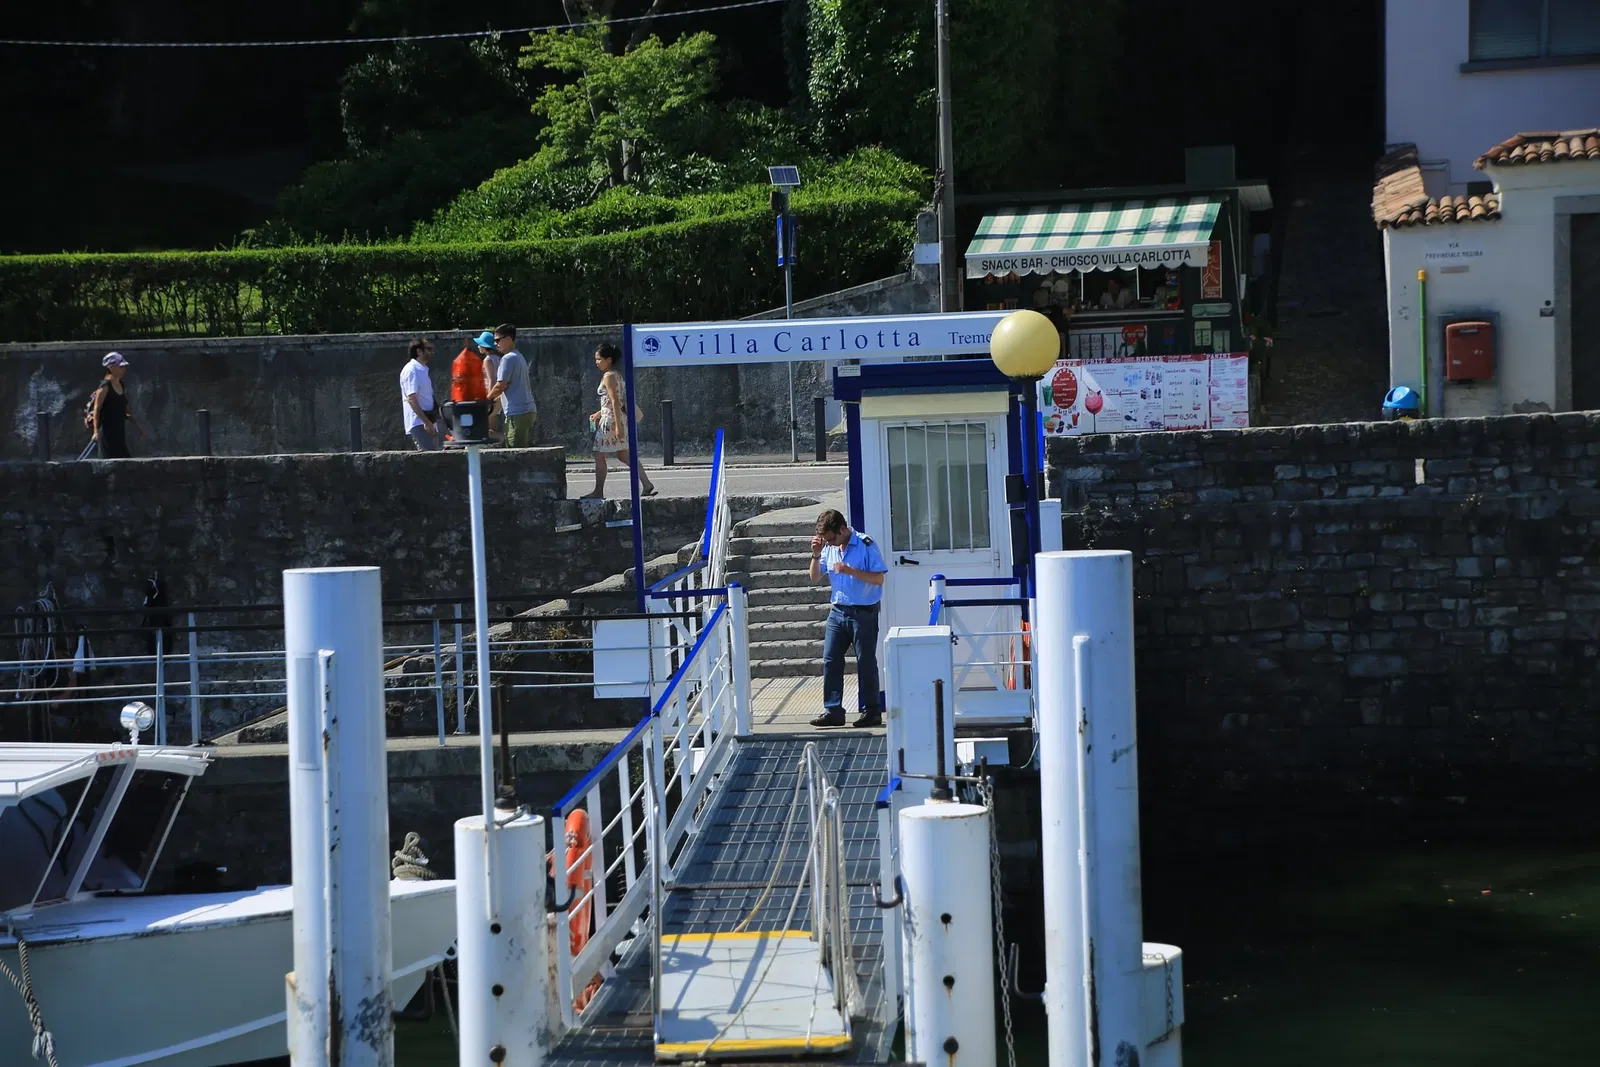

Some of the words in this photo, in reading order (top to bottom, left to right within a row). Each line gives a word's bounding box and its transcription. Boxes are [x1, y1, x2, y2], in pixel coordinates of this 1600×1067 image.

[981, 259, 1018, 271] SNACK
[1021, 257, 1043, 270] BAR
[1051, 254, 1099, 268] CHIOSCO
[1101, 252, 1132, 266] VILLA
[1133, 250, 1192, 265] CARLOTTA
[670, 333, 759, 356] Villa
[773, 328, 921, 353] Carlotta
[949, 331, 991, 346] Treme
